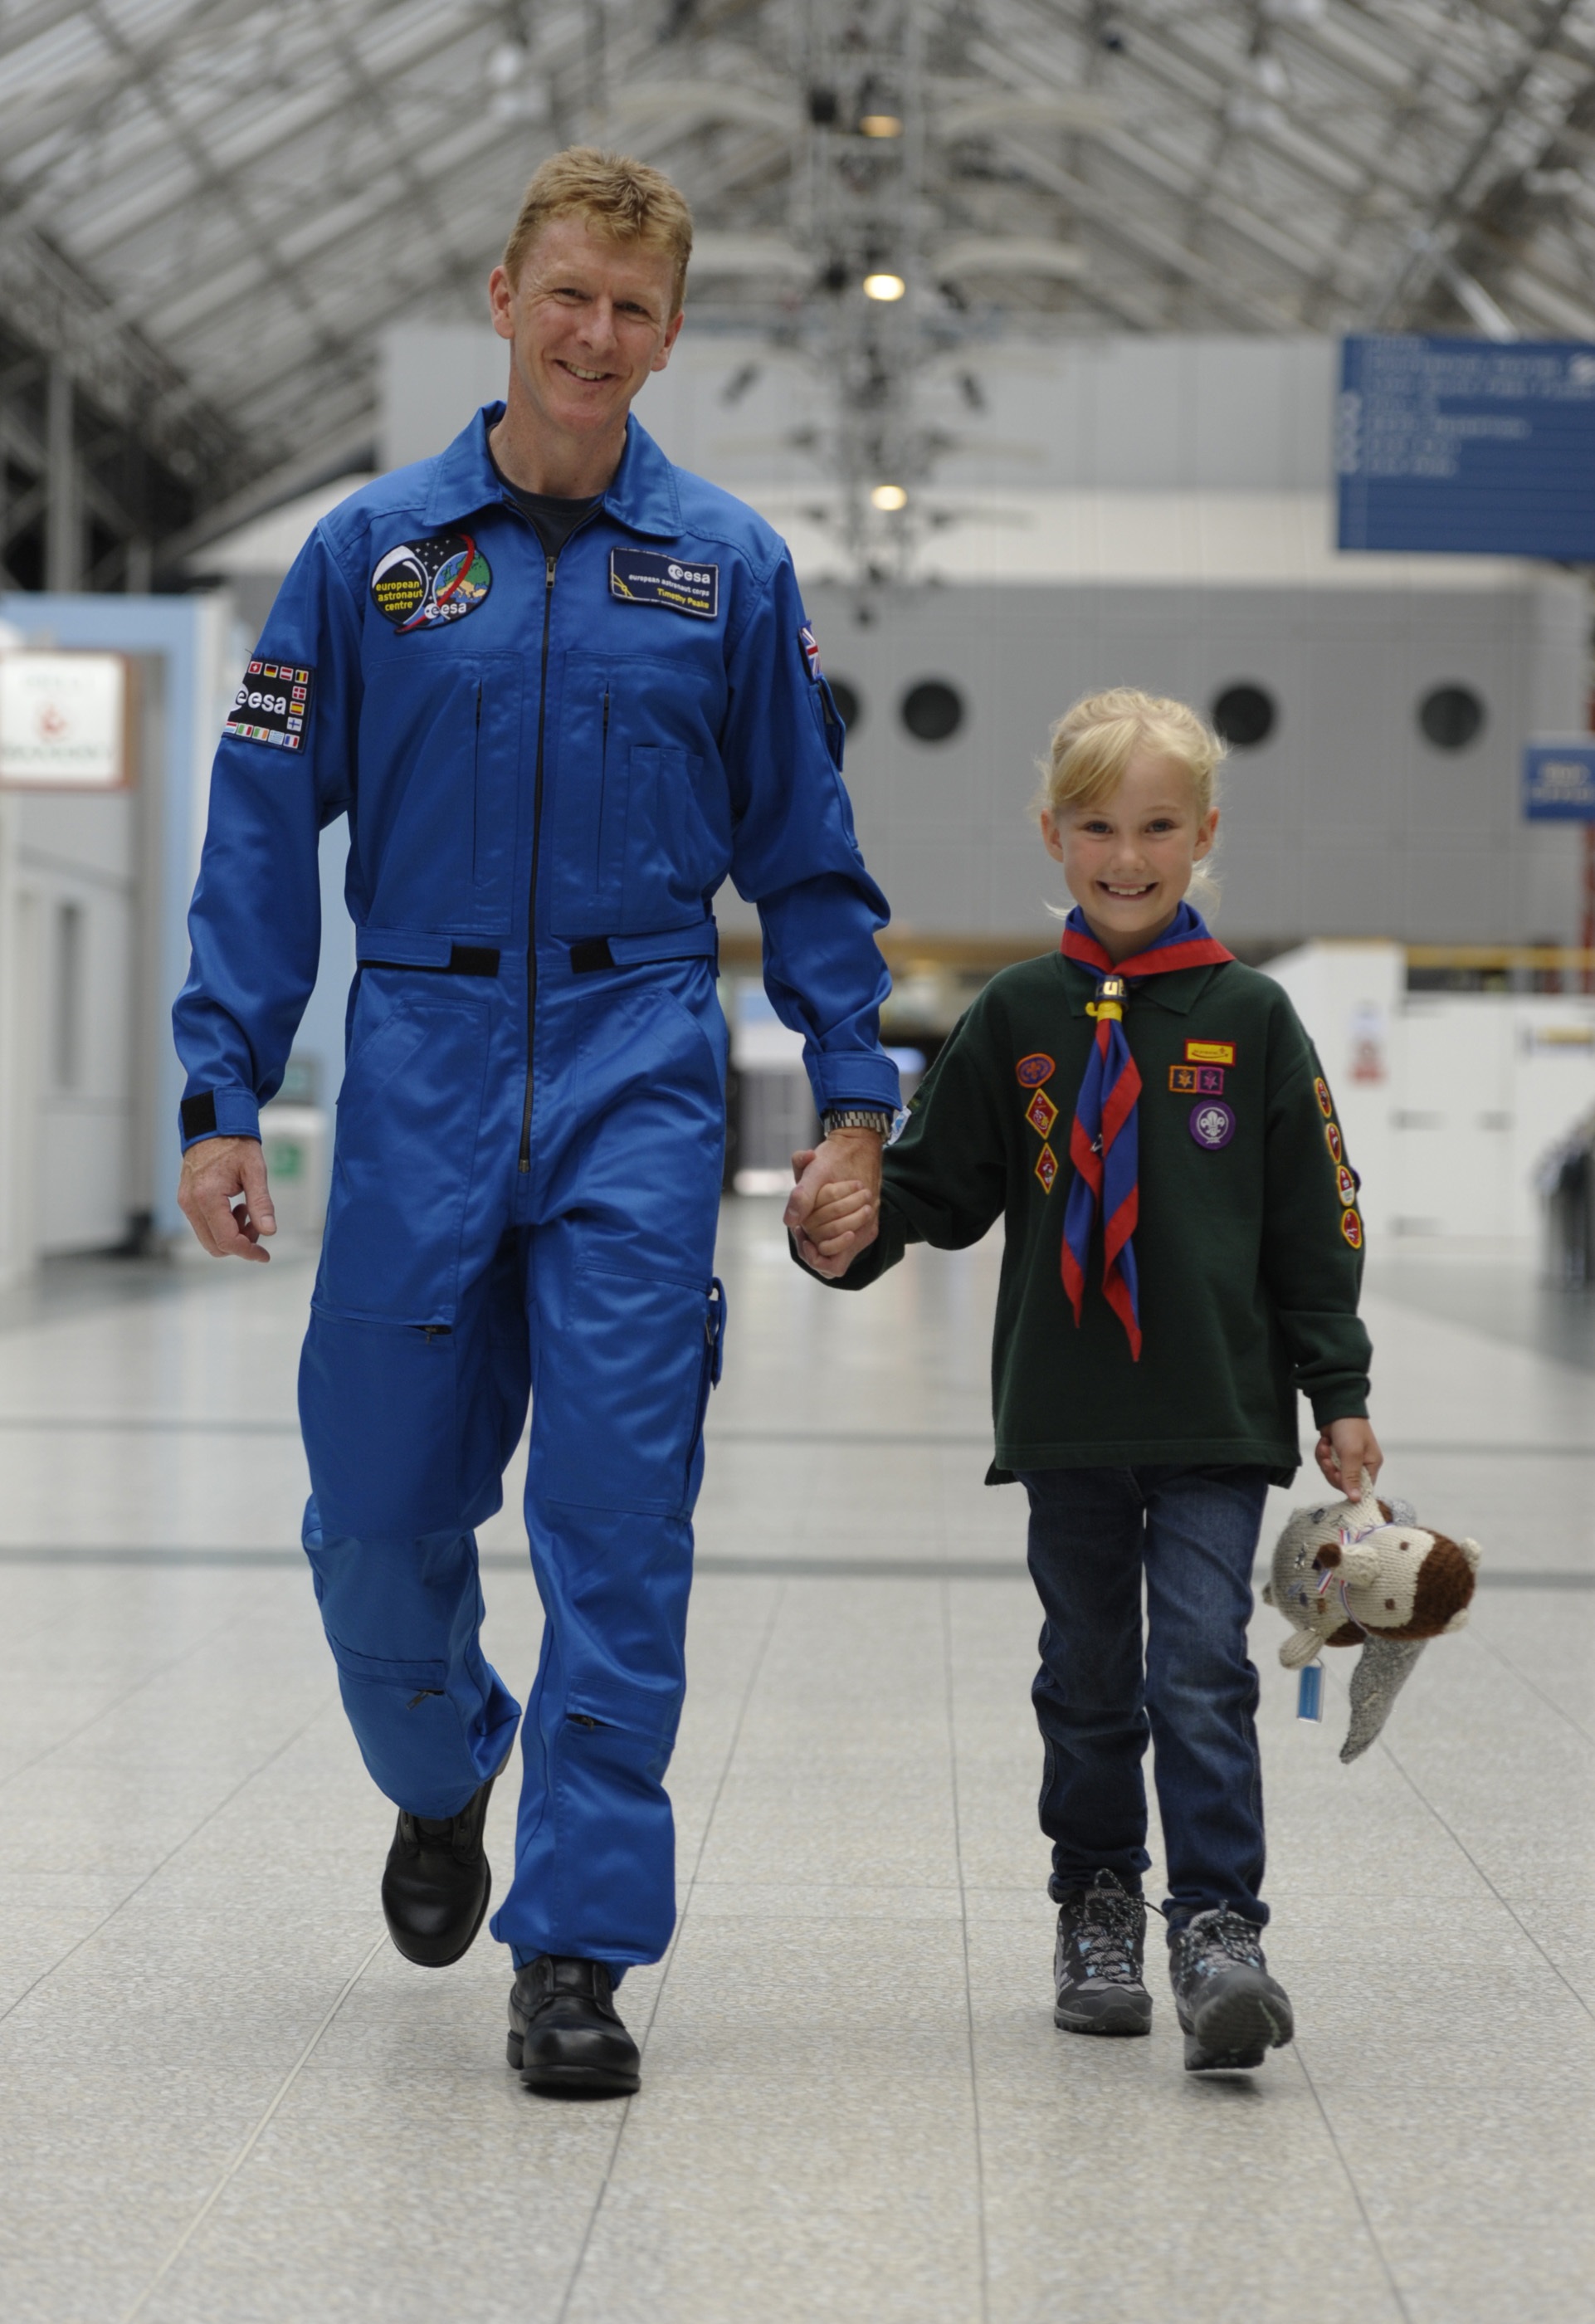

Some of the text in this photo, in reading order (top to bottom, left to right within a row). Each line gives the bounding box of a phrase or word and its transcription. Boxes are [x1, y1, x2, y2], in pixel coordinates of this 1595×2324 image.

[628, 574, 661, 583] european
[661, 579, 691, 592] astronaut
[685, 571, 710, 583] esa
[376, 581, 420, 591] european
[378, 589, 423, 602] astronaut
[657, 588, 710, 609] Timothy Peake
[385, 601, 413, 611] centre
[248, 692, 286, 715] esa
